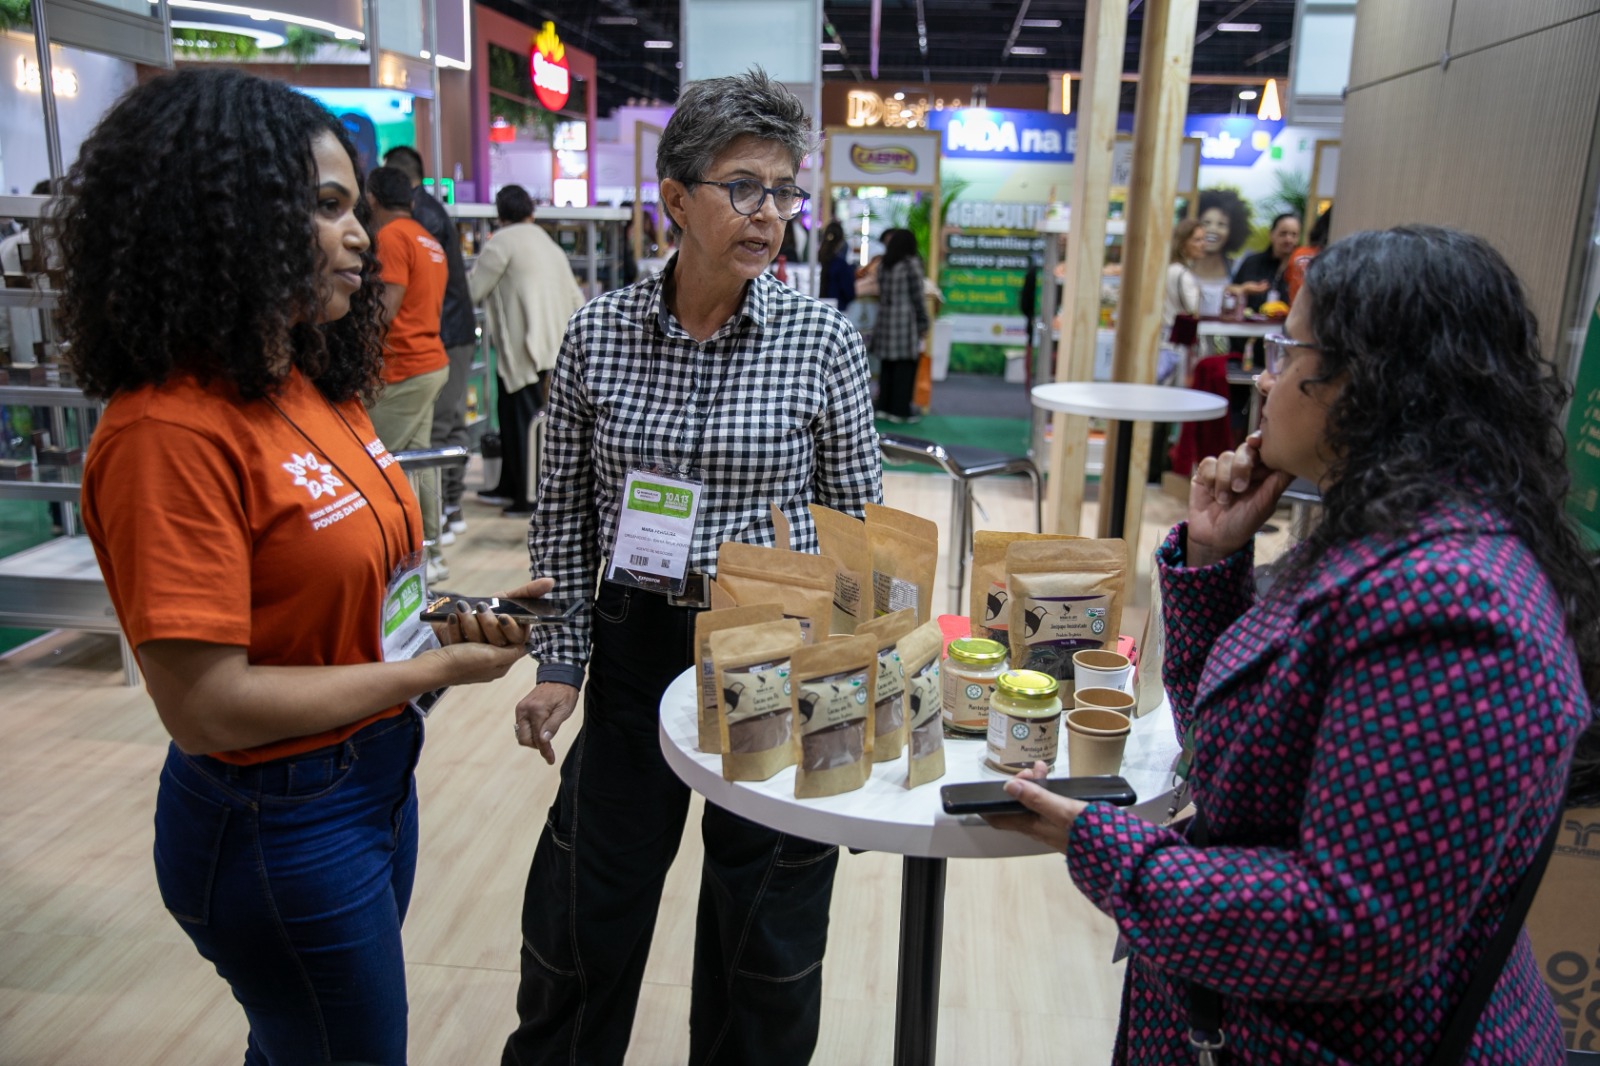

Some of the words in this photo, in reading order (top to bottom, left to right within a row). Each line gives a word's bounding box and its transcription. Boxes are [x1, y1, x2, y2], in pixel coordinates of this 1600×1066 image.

[948, 120, 1020, 152] MDA
[1021, 128, 1062, 154] na
[948, 254, 995, 269] campo
[996, 256, 1029, 269] para
[665, 492, 674, 502] 10
[313, 510, 345, 531] POVOS
[342, 504, 356, 517] DA
[1020, 745, 1043, 753] Manteiga
